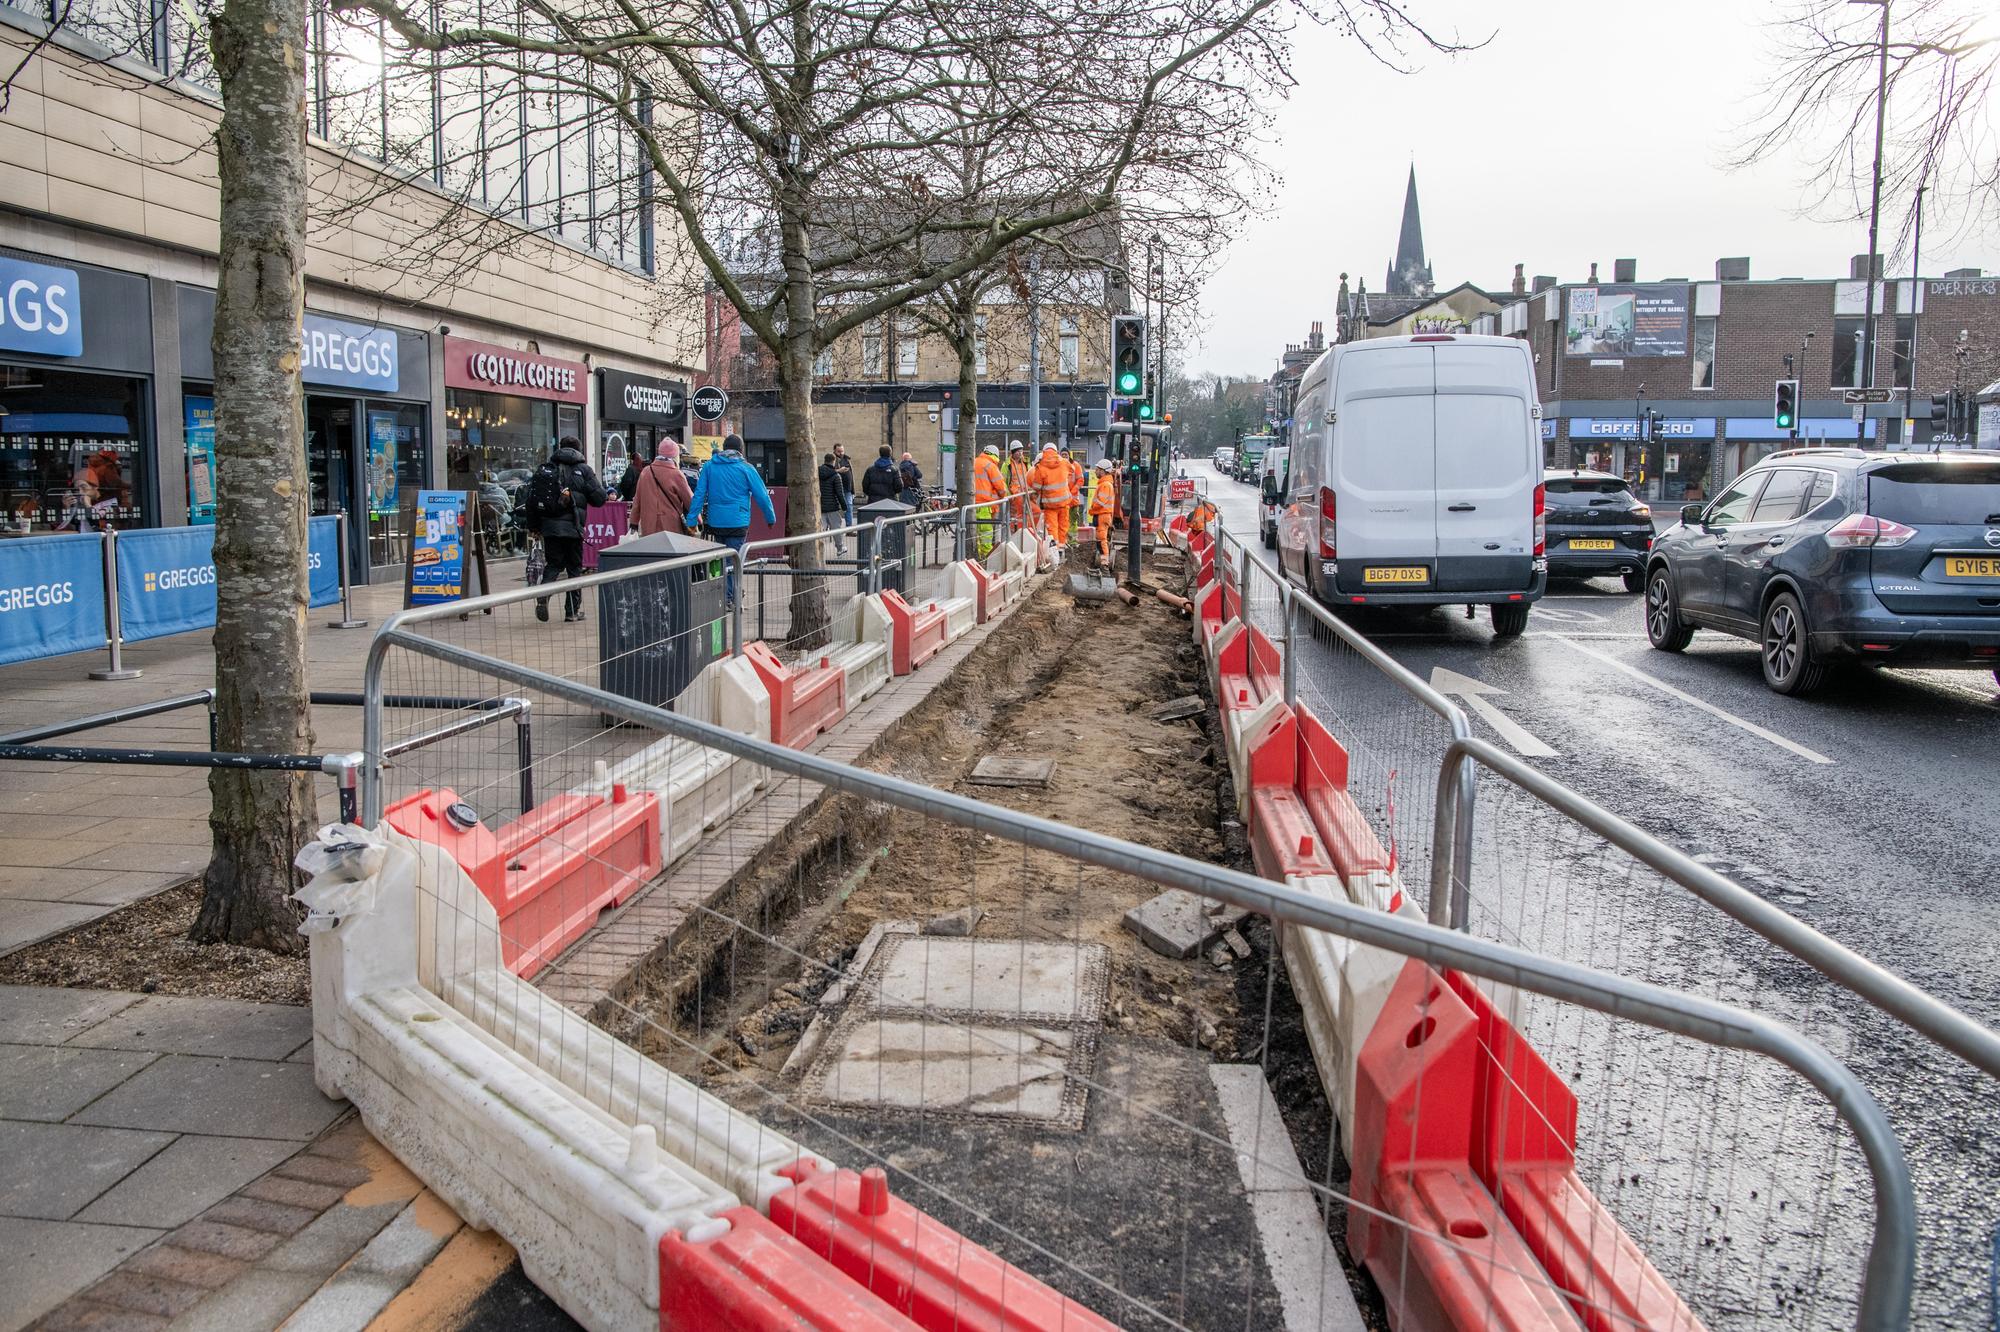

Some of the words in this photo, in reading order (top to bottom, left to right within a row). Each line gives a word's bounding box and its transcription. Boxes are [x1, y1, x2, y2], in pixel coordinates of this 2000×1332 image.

[0, 279, 69, 335] GS
[301, 328, 392, 378] GREGGS
[522, 362, 576, 392] COFFEE
[694, 398, 722, 406] COFFEE
[982, 412, 1009, 426] Tech
[426, 511, 439, 521] THE
[583, 523, 616, 539] STA
[1369, 569, 1398, 580] BG67
[1400, 569, 1422, 580] OXS
[1955, 559, 1988, 574] GY16
[159, 565, 216, 590] GREGGS
[0, 581, 74, 612] GREGGS
